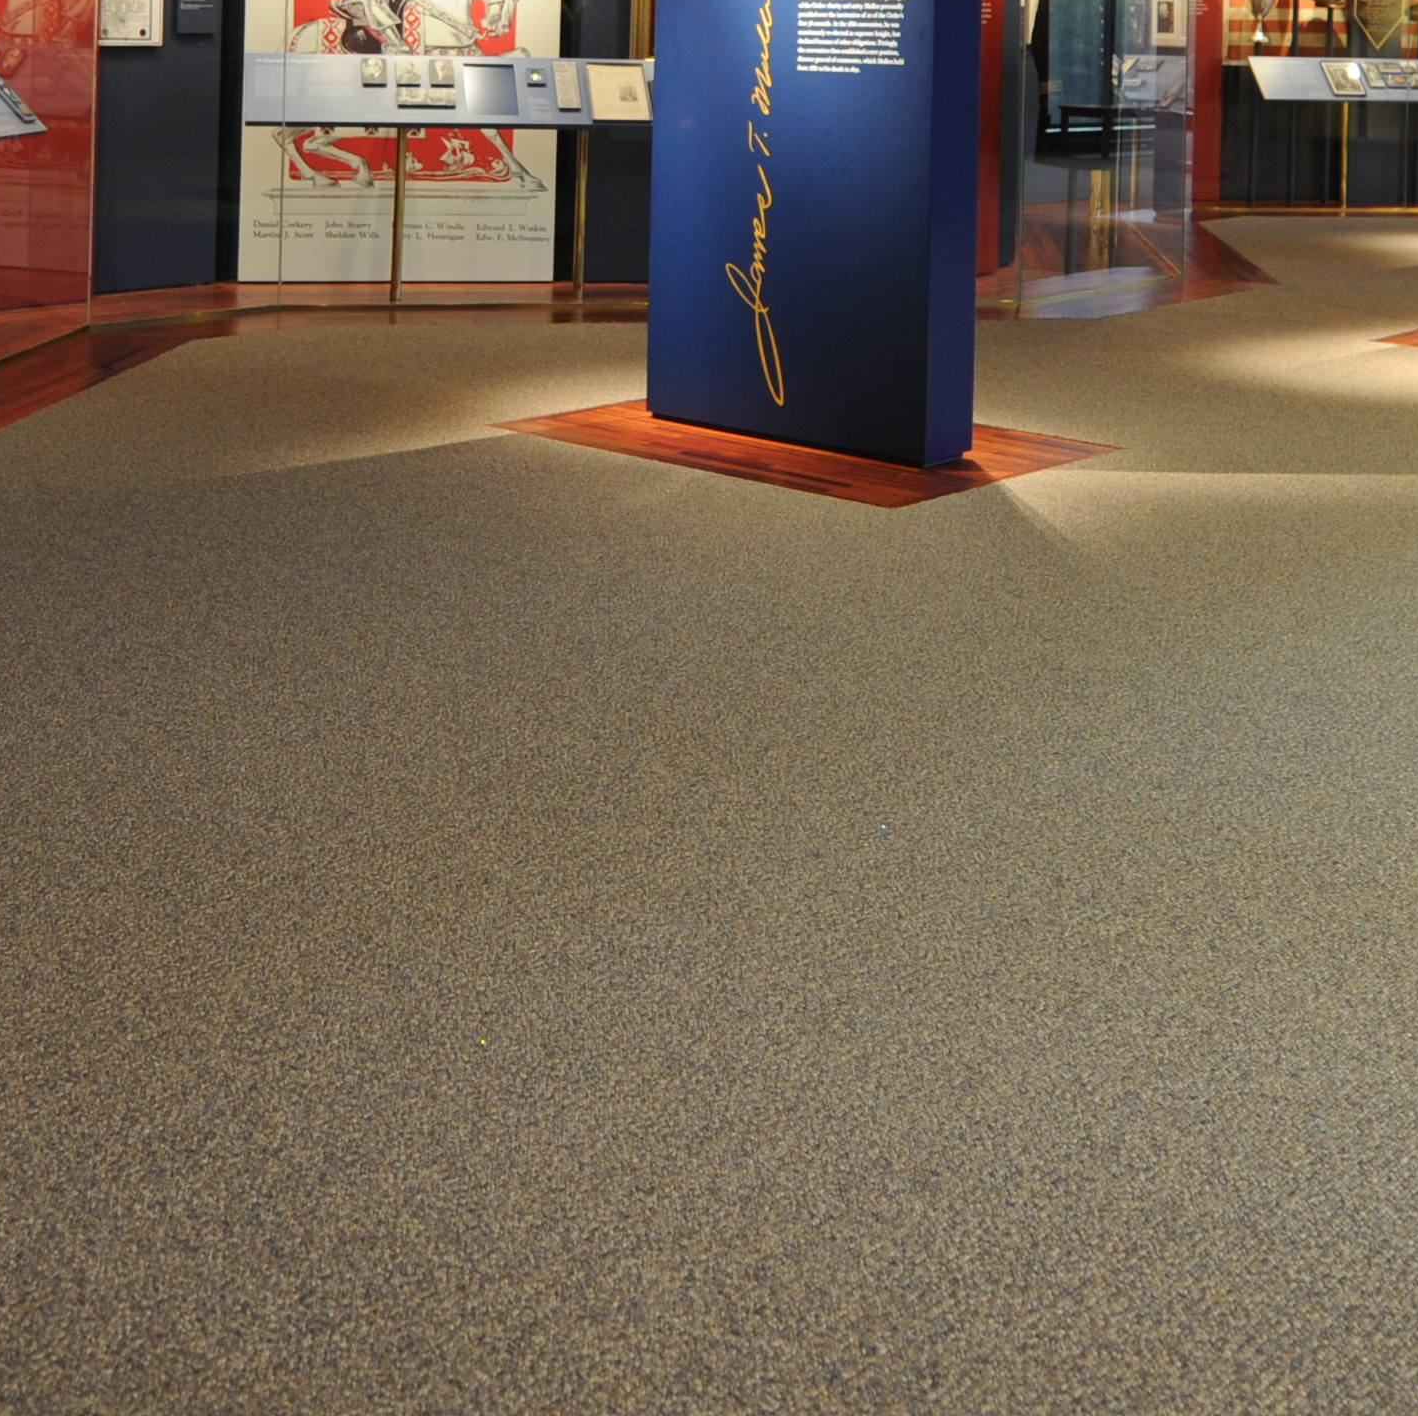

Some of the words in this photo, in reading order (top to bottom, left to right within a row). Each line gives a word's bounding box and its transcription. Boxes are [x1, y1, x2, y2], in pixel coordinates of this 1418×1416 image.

[747, 120, 771, 157] T.
[253, 220, 280, 229] Daniel
[325, 220, 344, 229] John
[726, 163, 784, 407] James
